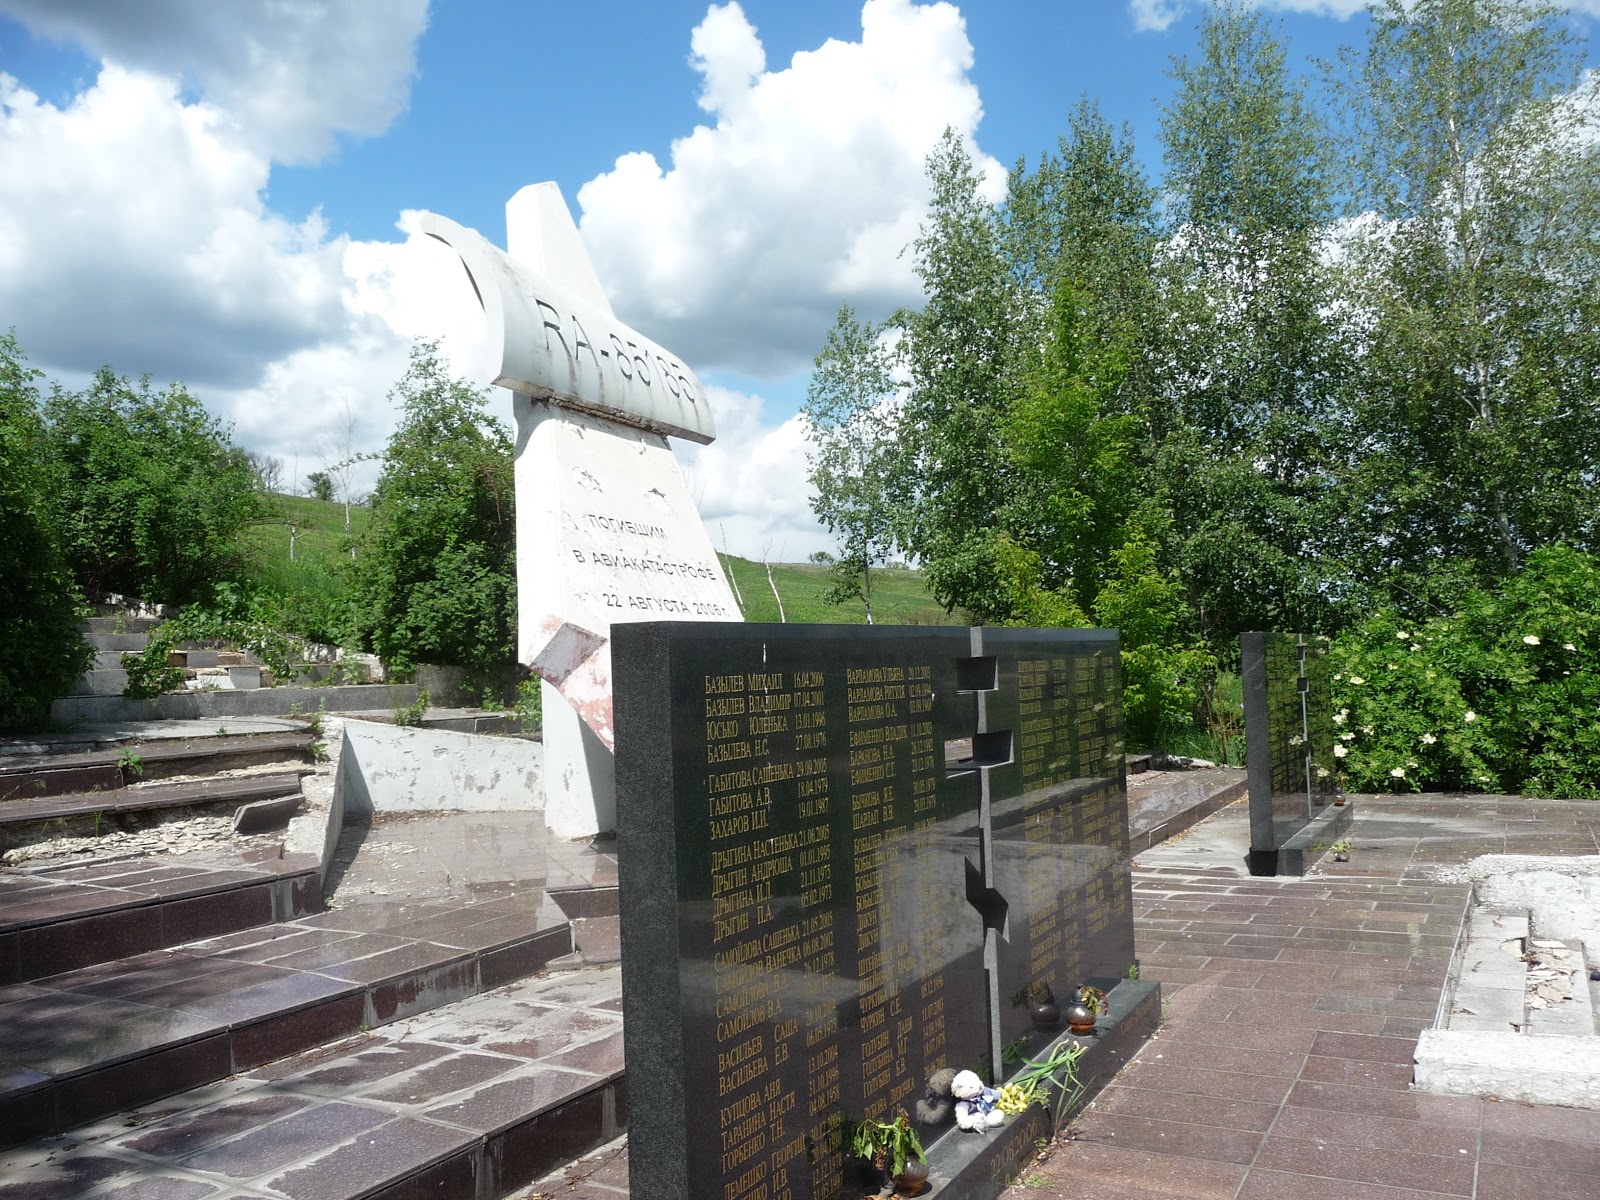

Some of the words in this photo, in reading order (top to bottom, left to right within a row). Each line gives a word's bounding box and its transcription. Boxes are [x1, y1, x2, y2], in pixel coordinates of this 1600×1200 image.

[535, 298, 698, 404] RA-85185
[588, 514, 668, 541] ПОГИБШИМ
[573, 549, 585, 563] В
[592, 552, 717, 581] АВИАКАТАСТРОФЕ
[602, 593, 622, 608] 22
[629, 595, 691, 613] АВГУСТА
[705, 675, 744, 694] БАЗЫЛЕВ
[748, 673, 782, 691] МИХАИЛ
[793, 671, 824, 688] 16.04.2006
[847, 668, 882, 684] ВАРЛАМОВА
[705, 698, 744, 717] БАЗЫЛЕВ
[748, 695, 791, 713] ВЛАДИМИР
[794, 691, 824, 708] 07.04.2001
[847, 688, 883, 703] ВАРЛАМОВА
[706, 721, 738, 740] ЮСЬКО
[749, 716, 788, 735] ЮЛЕНЬКА
[795, 711, 825, 729] 13.01.1996
[848, 705, 884, 722] ВАРЛАМОВА
[707, 742, 751, 763] БАЗЫЛЕВА
[755, 737, 769, 756] Н.С.
[795, 731, 826, 750] 27.08.1976
[849, 729, 883, 747] ЕФИМЕНКО
[850, 748, 881, 766] БАРАНОВА
[708, 771, 752, 793] ГАБИТОВА
[752, 764, 793, 785] САШЕНЬКА
[796, 757, 827, 777] 29.09.2005
[851, 766, 884, 785] ЕФИМЕНКО
[709, 793, 753, 817] ГАБИТОВА
[756, 786, 772, 807] А.В.
[798, 777, 828, 798] 18.04.1979
[852, 790, 880, 810] БЫЧКОВА
[710, 816, 749, 840] ЗАХАРОВ
[752, 809, 768, 830] И.И.
[853, 810, 879, 830] ШАРЛАП
[711, 845, 752, 874] ДРЫГИНА
[754, 833, 798, 860] НАСТЕНЬКА
[854, 834, 881, 855] БОБЫЛЕВ
[712, 869, 747, 897] ДРЫГИН
[751, 856, 793, 883] АНДРЮША
[800, 844, 830, 868] 01.01.1995
[713, 890, 753, 920] ДРЫГИНА
[800, 864, 830, 889] 21.11.1975
[713, 913, 748, 943] ДРЫГИН
[757, 902, 774, 925] П.А.
[715, 938, 761, 972] САМОЙЛОВА
[763, 923, 800, 952] САШЕНЬКА
[715, 960, 763, 995] САМОЙЛОВ
[766, 944, 801, 974] ВАНЕЧКА
[716, 980, 768, 1019] САМОЙЛОВА
[717, 1004, 765, 1043] САМОЙЛОВ
[860, 1008, 884, 1034] ЧУРКИН
[718, 1035, 762, 1073] ВАСИЛЬЕВ
[774, 1017, 798, 1044] САША
[862, 1030, 889, 1060] ГОЛУБИН
[719, 1055, 768, 1096] ВАСИЛЬЕВА
[775, 1041, 789, 1066] Е.В.
[862, 1047, 893, 1079] ГОЛУБИНА
[863, 1067, 891, 1099] ГОЛУБИН
[721, 1089, 761, 1129] КУПЦОВА
[764, 1078, 781, 1103] АНЯ
[721, 1109, 766, 1152] ТАРАНИНА
[769, 1092, 795, 1122] НАСТЯ
[722, 1132, 765, 1174] ГОРБЕНКО
[770, 1116, 785, 1144] Т.Н.
[771, 1133, 805, 1172] ГЕОРГИЙ
